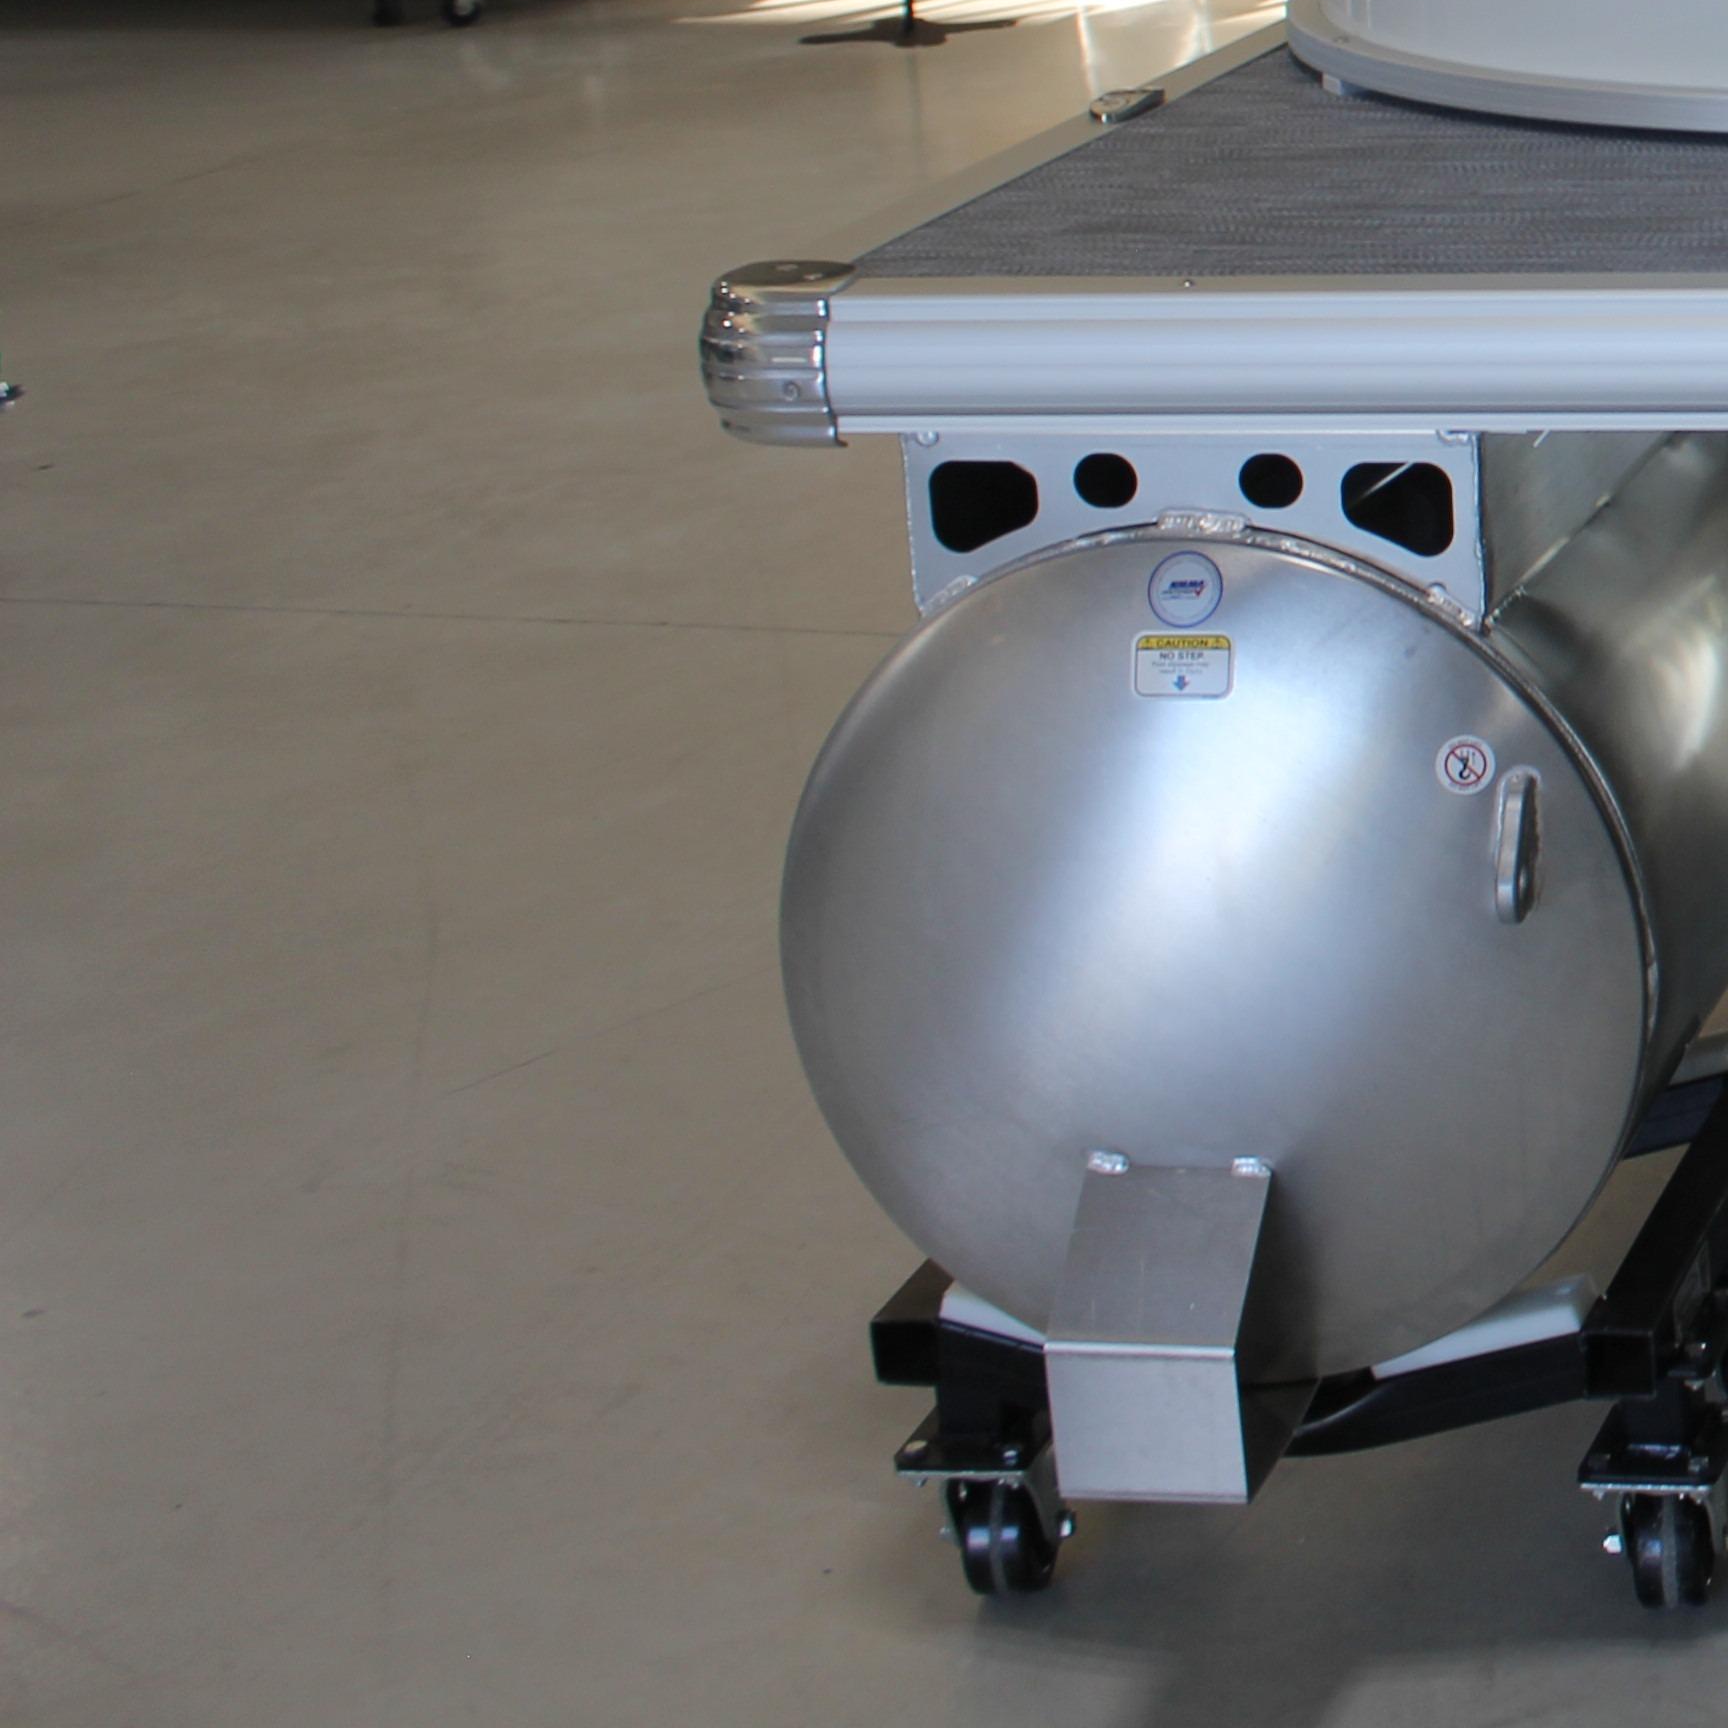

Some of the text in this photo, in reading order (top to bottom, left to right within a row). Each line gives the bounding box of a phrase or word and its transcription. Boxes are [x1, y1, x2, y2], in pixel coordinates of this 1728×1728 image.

[1156, 638, 1209, 648] CAUTION
[1160, 652, 1204, 660] NO STEP
